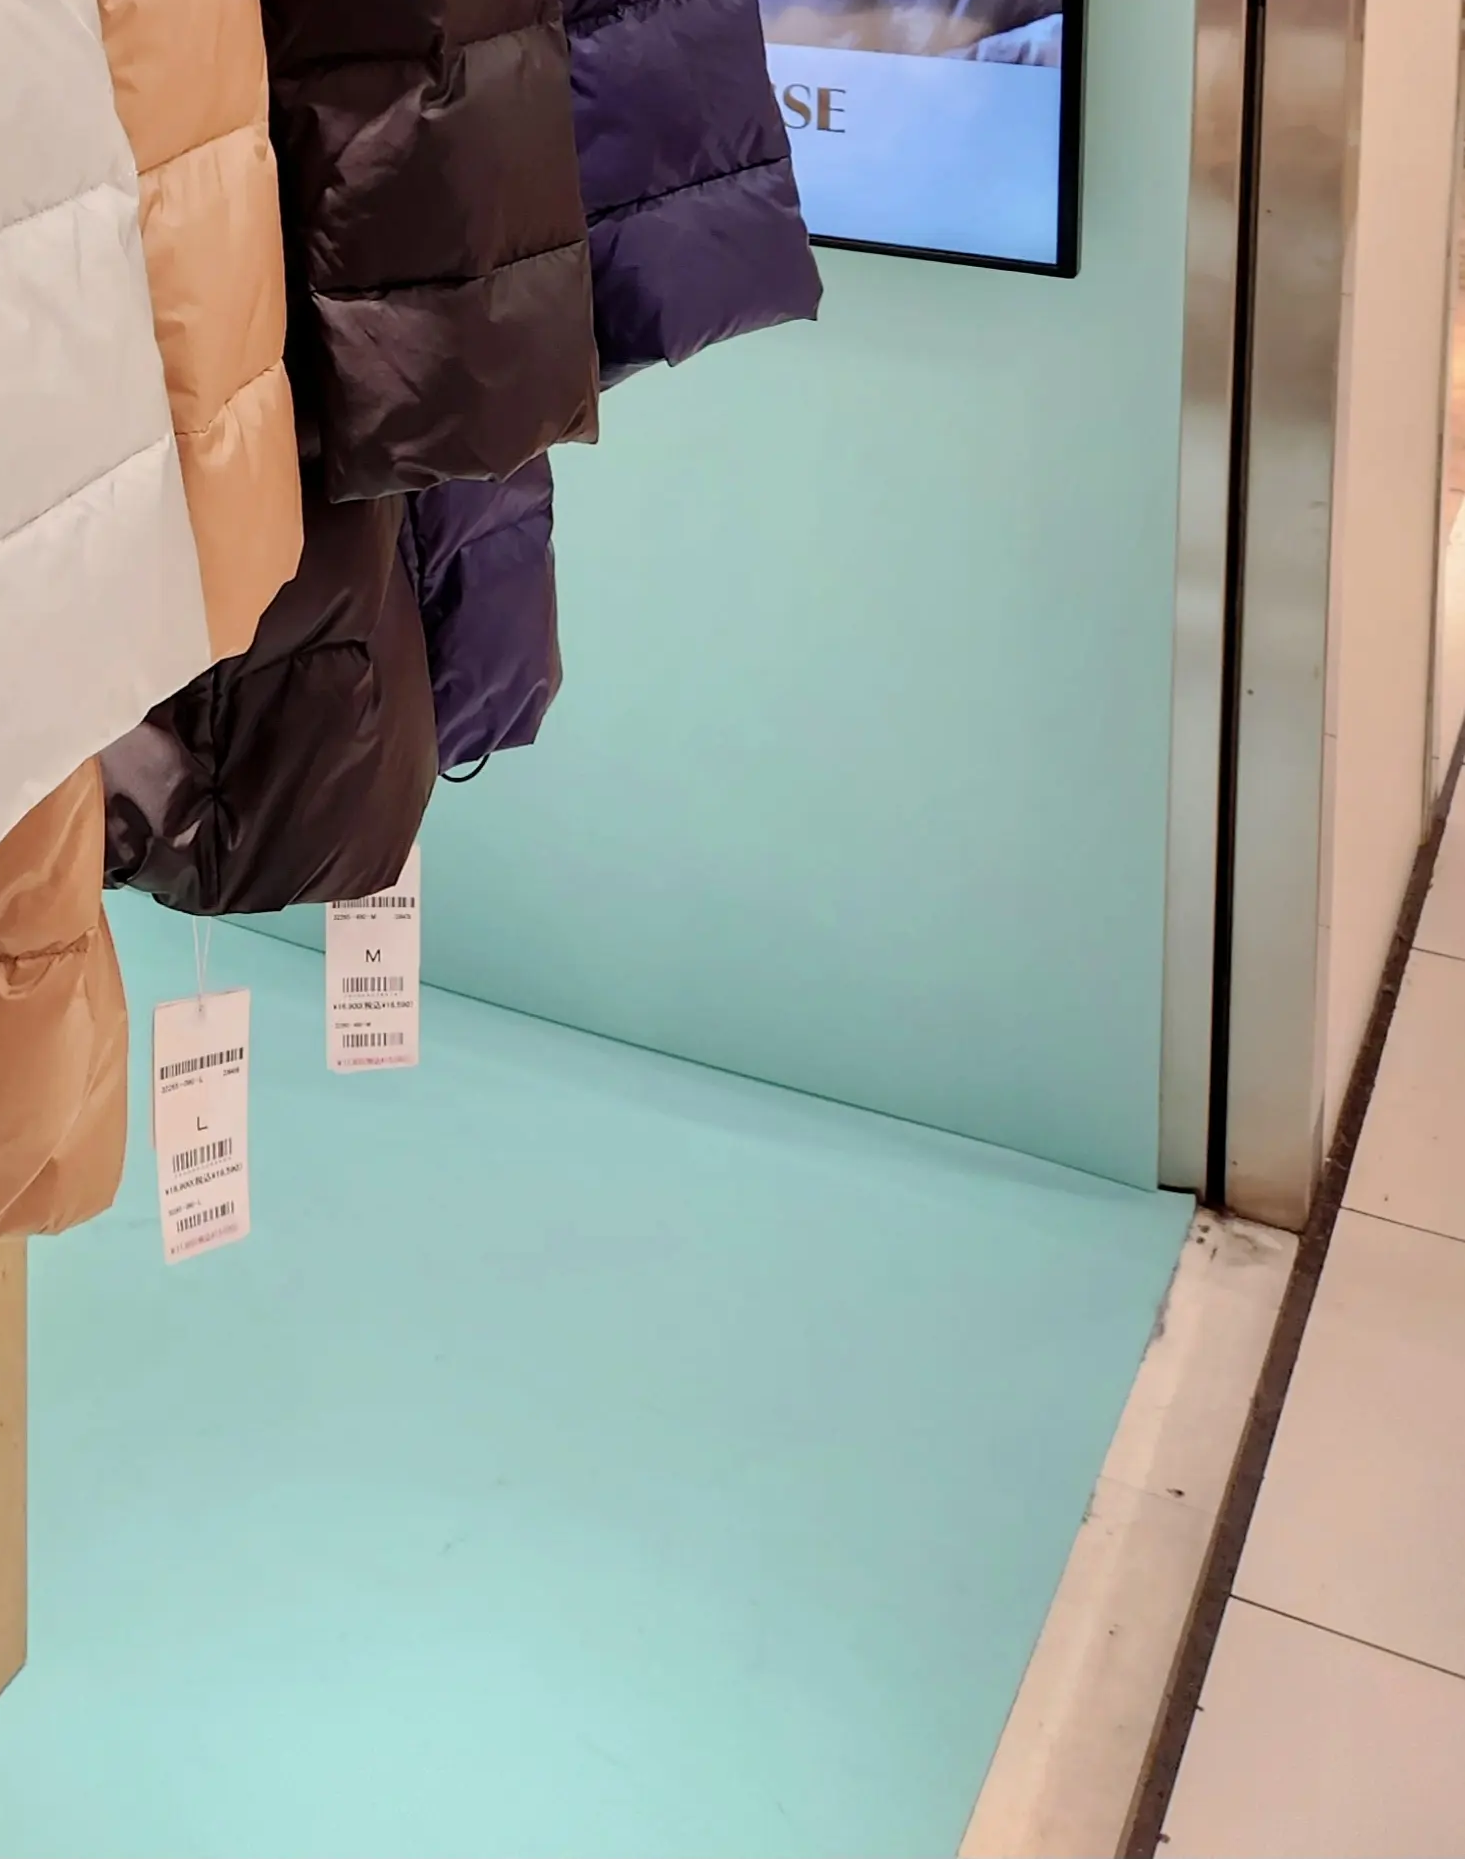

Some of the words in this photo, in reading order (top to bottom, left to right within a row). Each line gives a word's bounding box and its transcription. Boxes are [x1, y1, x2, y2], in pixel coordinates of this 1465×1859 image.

[772, 83, 847, 133] SE
[365, 948, 382, 963] M
[196, 1115, 209, 1131] L
